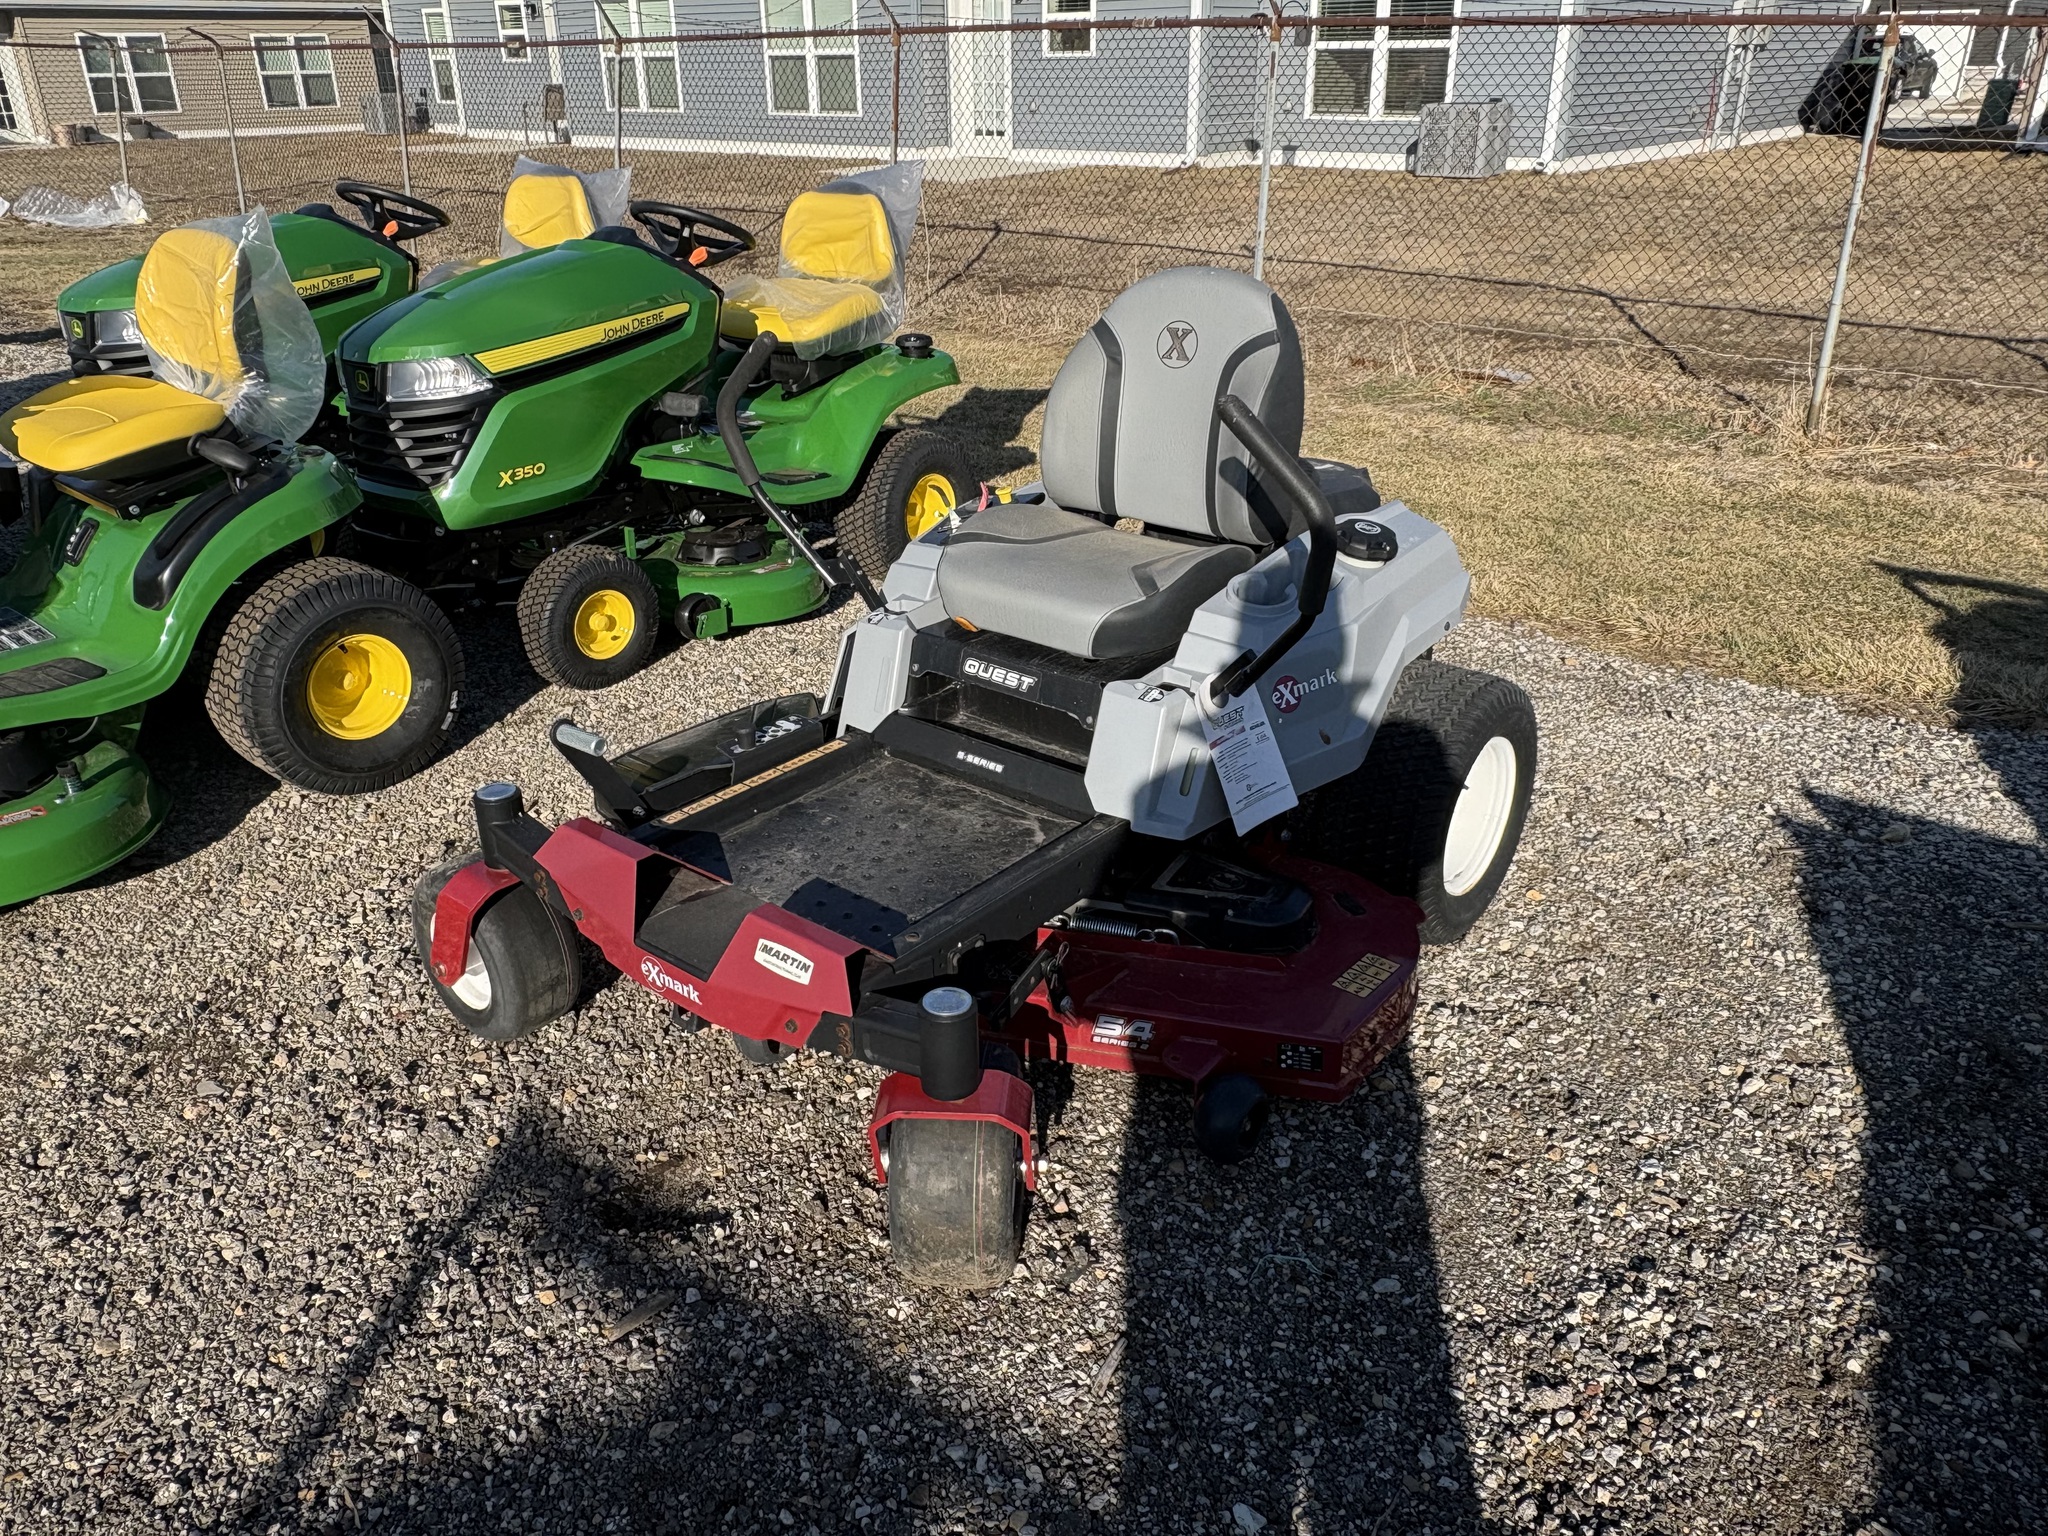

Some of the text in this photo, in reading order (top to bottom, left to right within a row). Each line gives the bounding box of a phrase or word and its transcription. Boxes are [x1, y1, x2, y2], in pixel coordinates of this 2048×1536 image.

[295, 274, 356, 296] OHN DEERE
[600, 311, 665, 342] JOHN DEERE
[1160, 325, 1194, 363] X
[497, 462, 546, 489] X350
[964, 658, 1037, 691] QUEST
[1272, 669, 1338, 709] eXmark
[759, 943, 811, 974] MARTIN
[641, 960, 702, 1006] eXmark
[1093, 1015, 1154, 1041] 54
